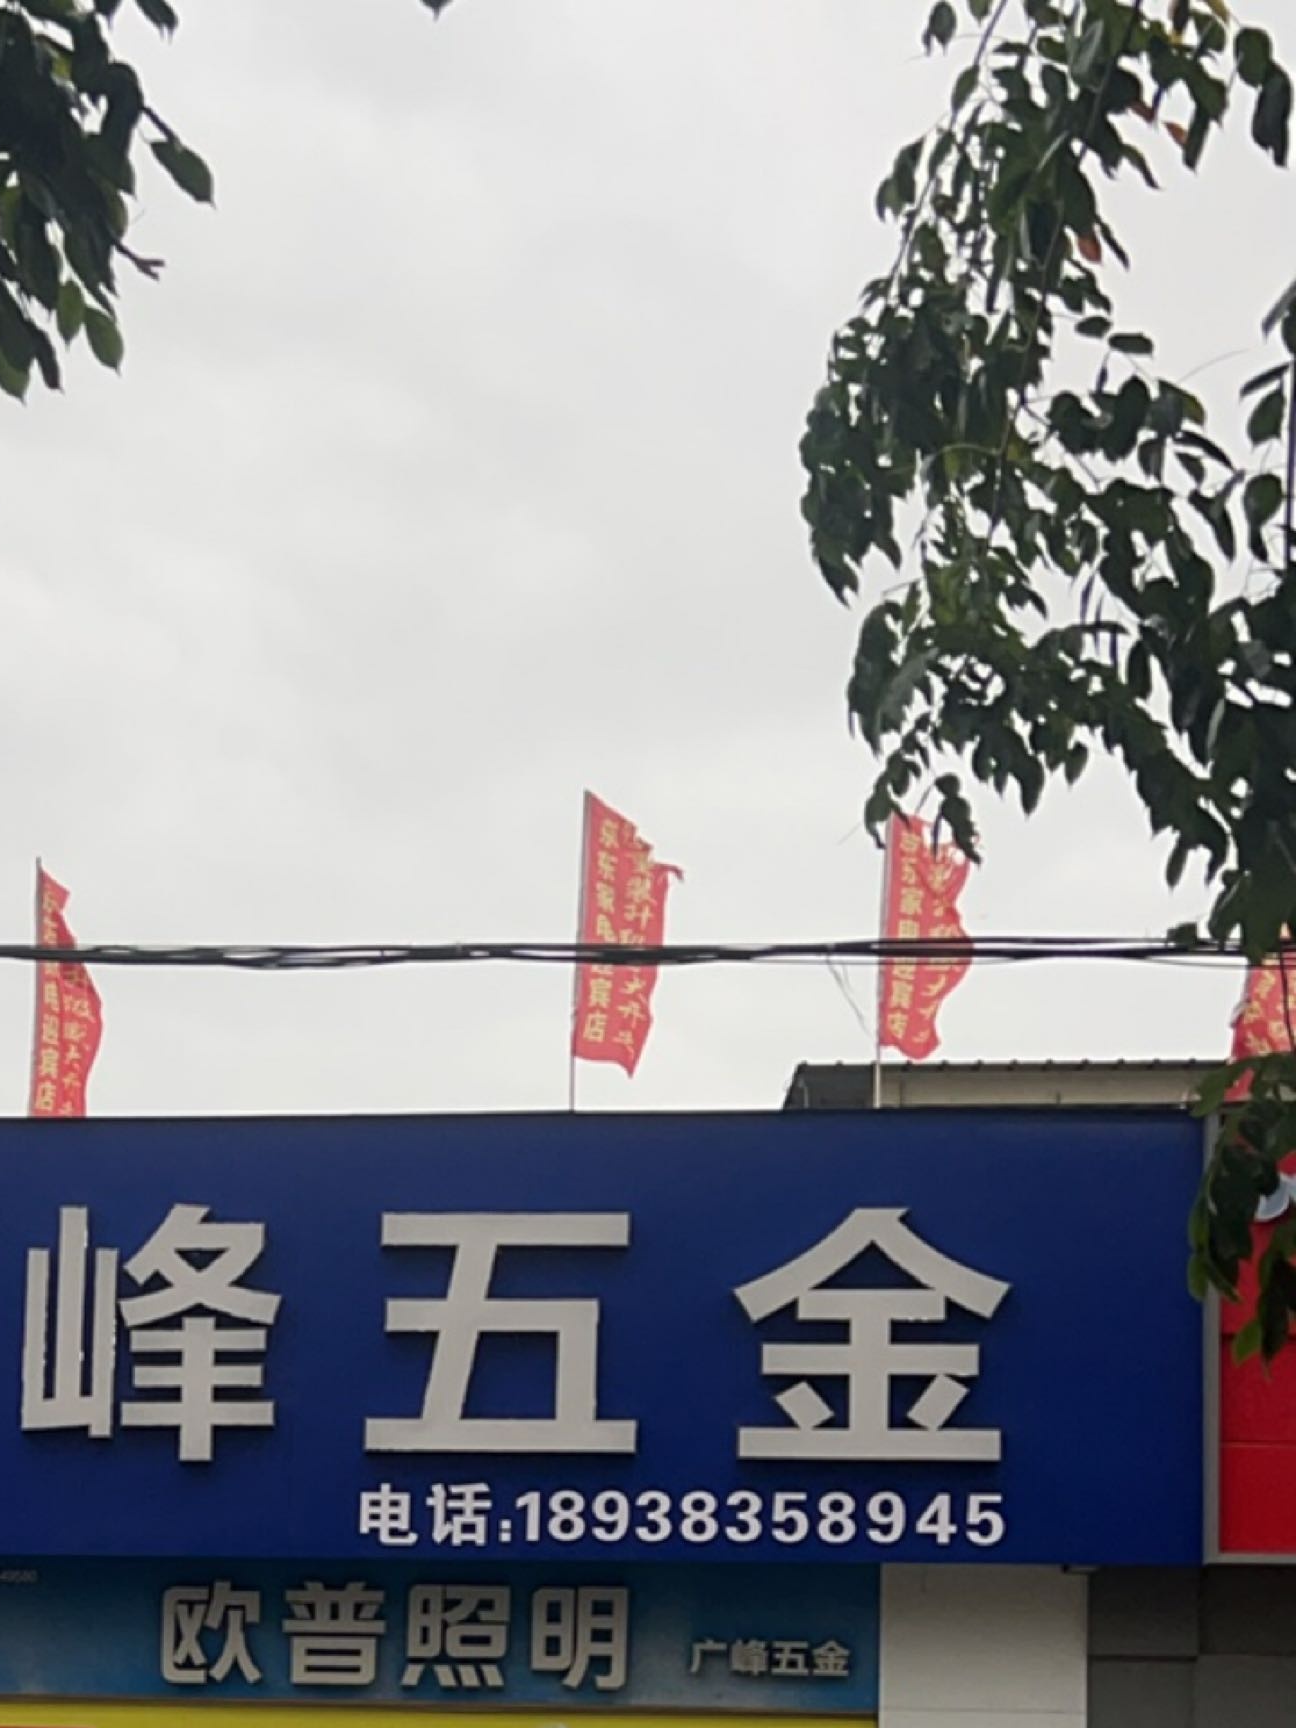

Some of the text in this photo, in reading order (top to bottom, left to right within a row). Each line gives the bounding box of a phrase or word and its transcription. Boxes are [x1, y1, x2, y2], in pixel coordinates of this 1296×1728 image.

[359, 1482, 1006, 1547] 电话:18938358945
[160, 1581, 630, 1690] 欧普照明
[689, 1638, 850, 1677] 广峰五金
